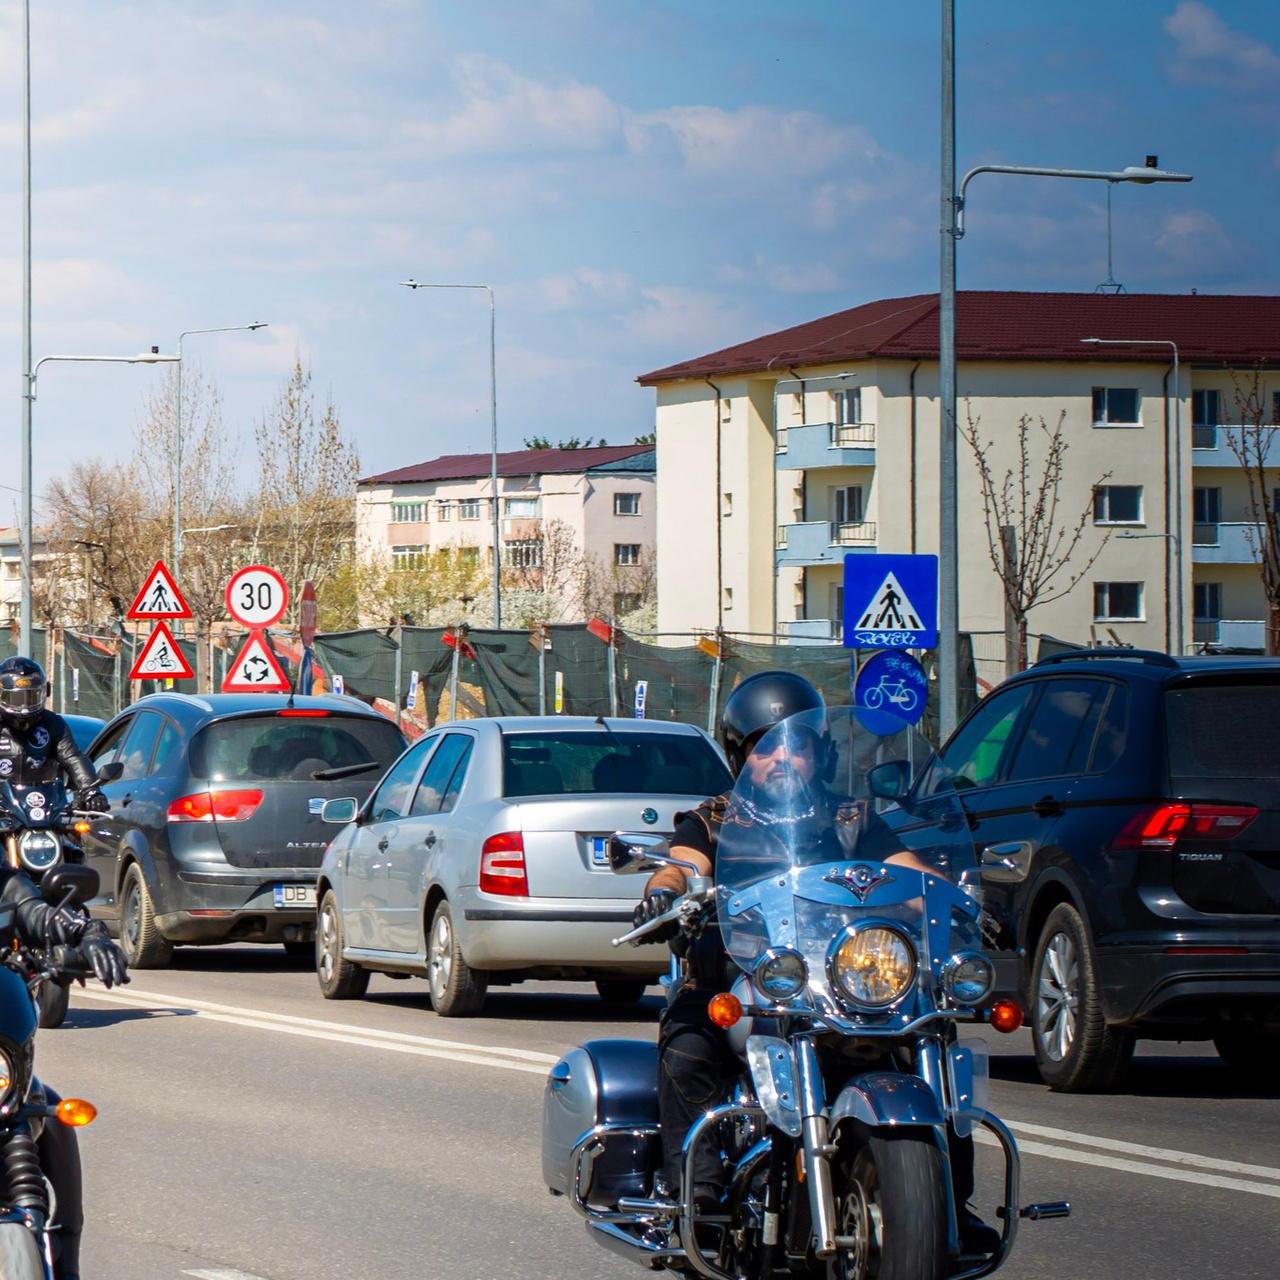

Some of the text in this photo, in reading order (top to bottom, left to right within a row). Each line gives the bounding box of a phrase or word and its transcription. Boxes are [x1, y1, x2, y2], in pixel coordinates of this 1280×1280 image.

[241, 582, 272, 611] 30
[1179, 853, 1223, 861] TIGUAN
[284, 886, 307, 901] DB
